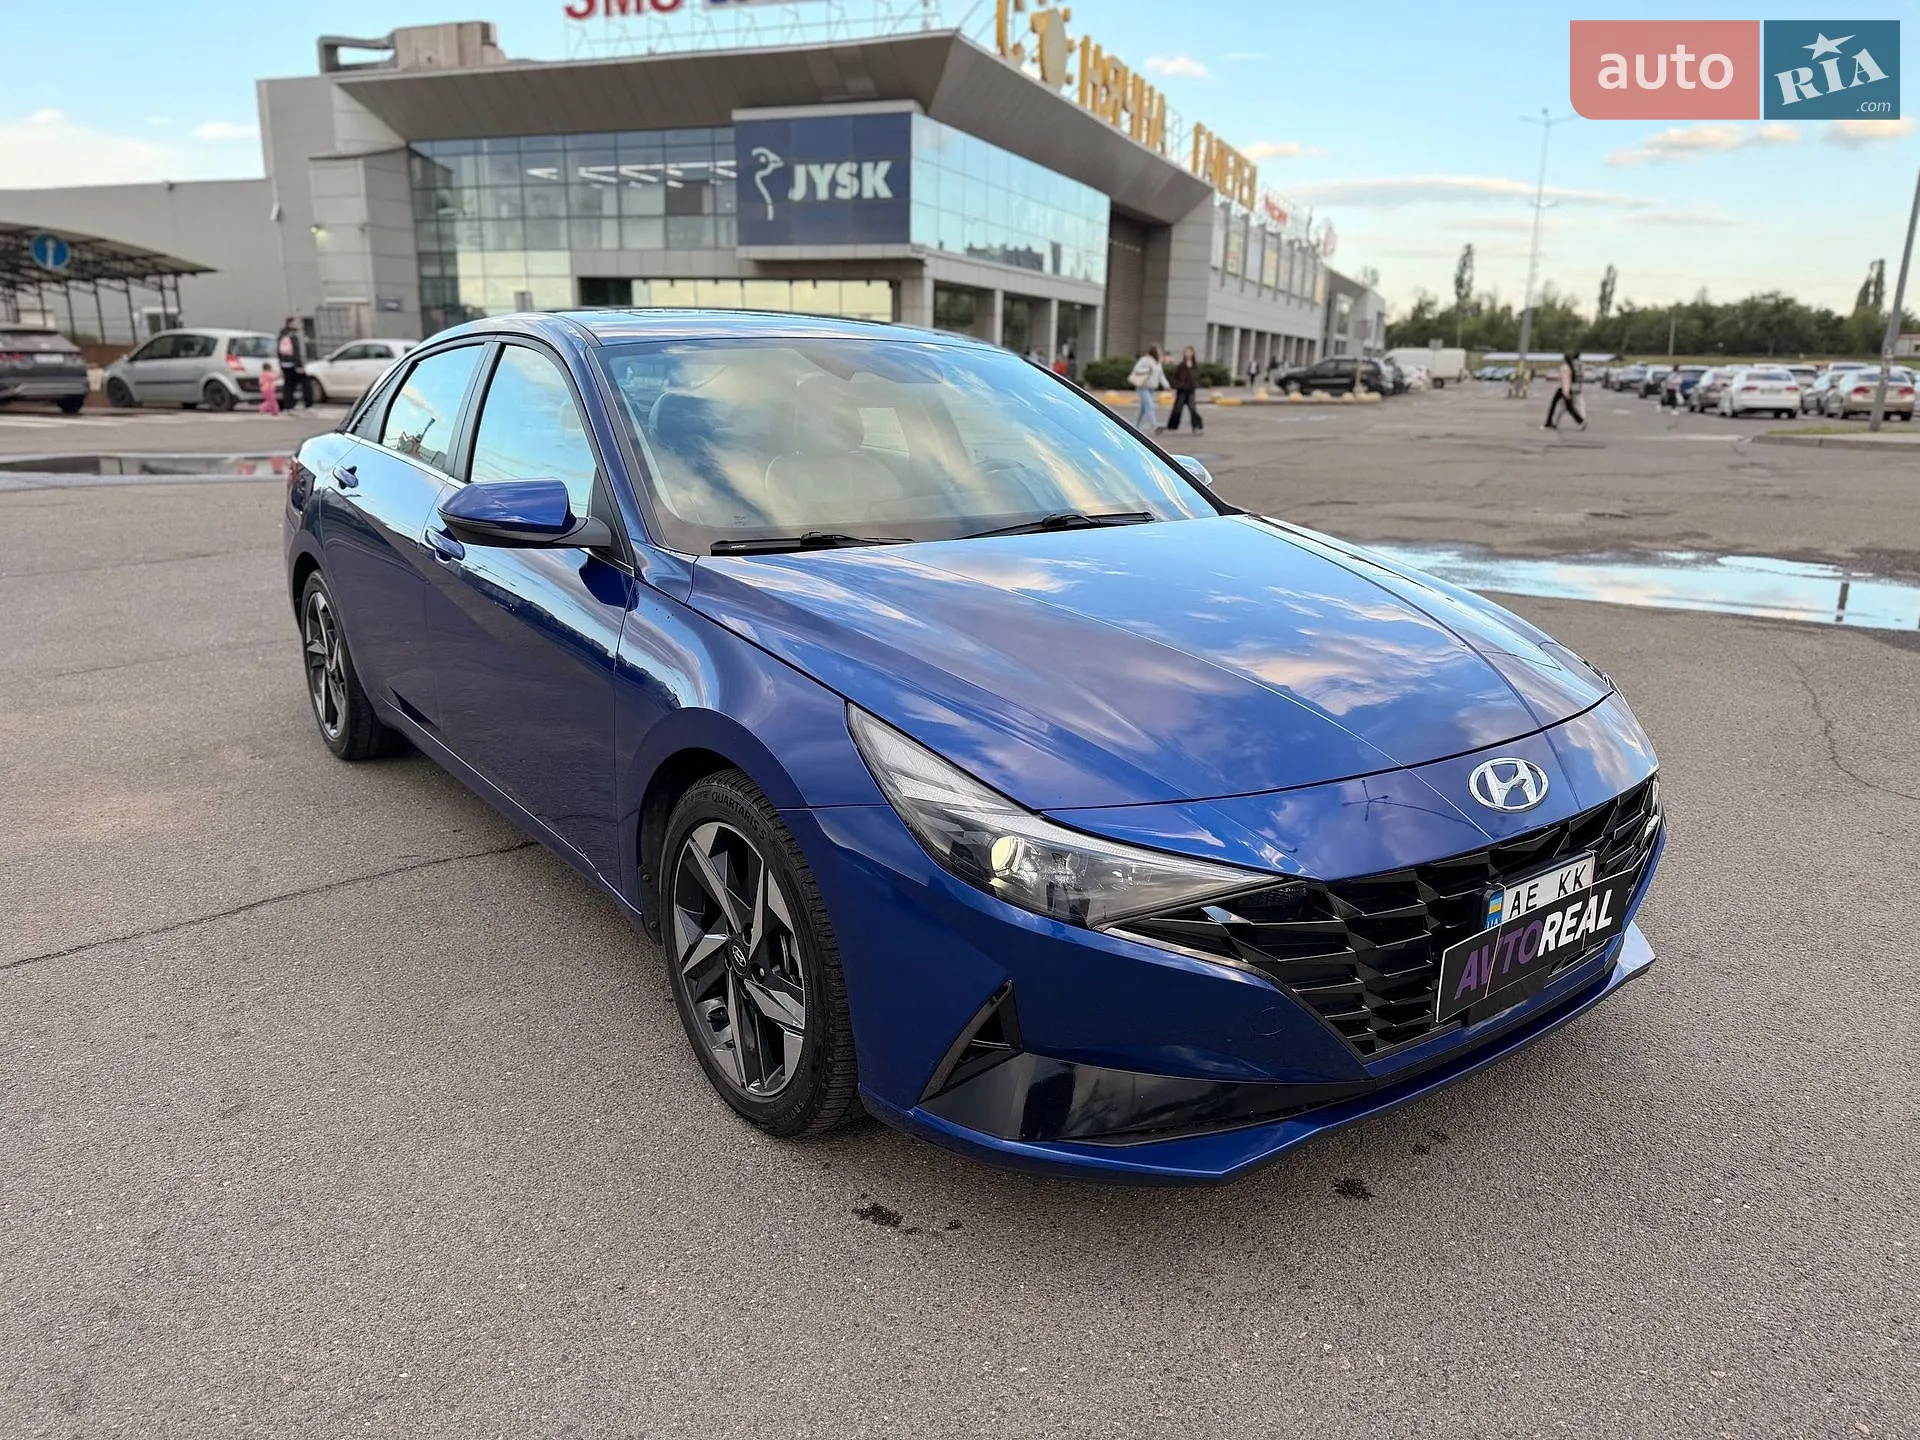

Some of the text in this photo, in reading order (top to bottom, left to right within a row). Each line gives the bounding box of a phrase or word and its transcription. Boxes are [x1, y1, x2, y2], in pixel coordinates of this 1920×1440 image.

[788, 160, 893, 202] JYSK
[711, 791, 760, 831] QUARTARIS
[1509, 863, 1587, 919] AE KK
